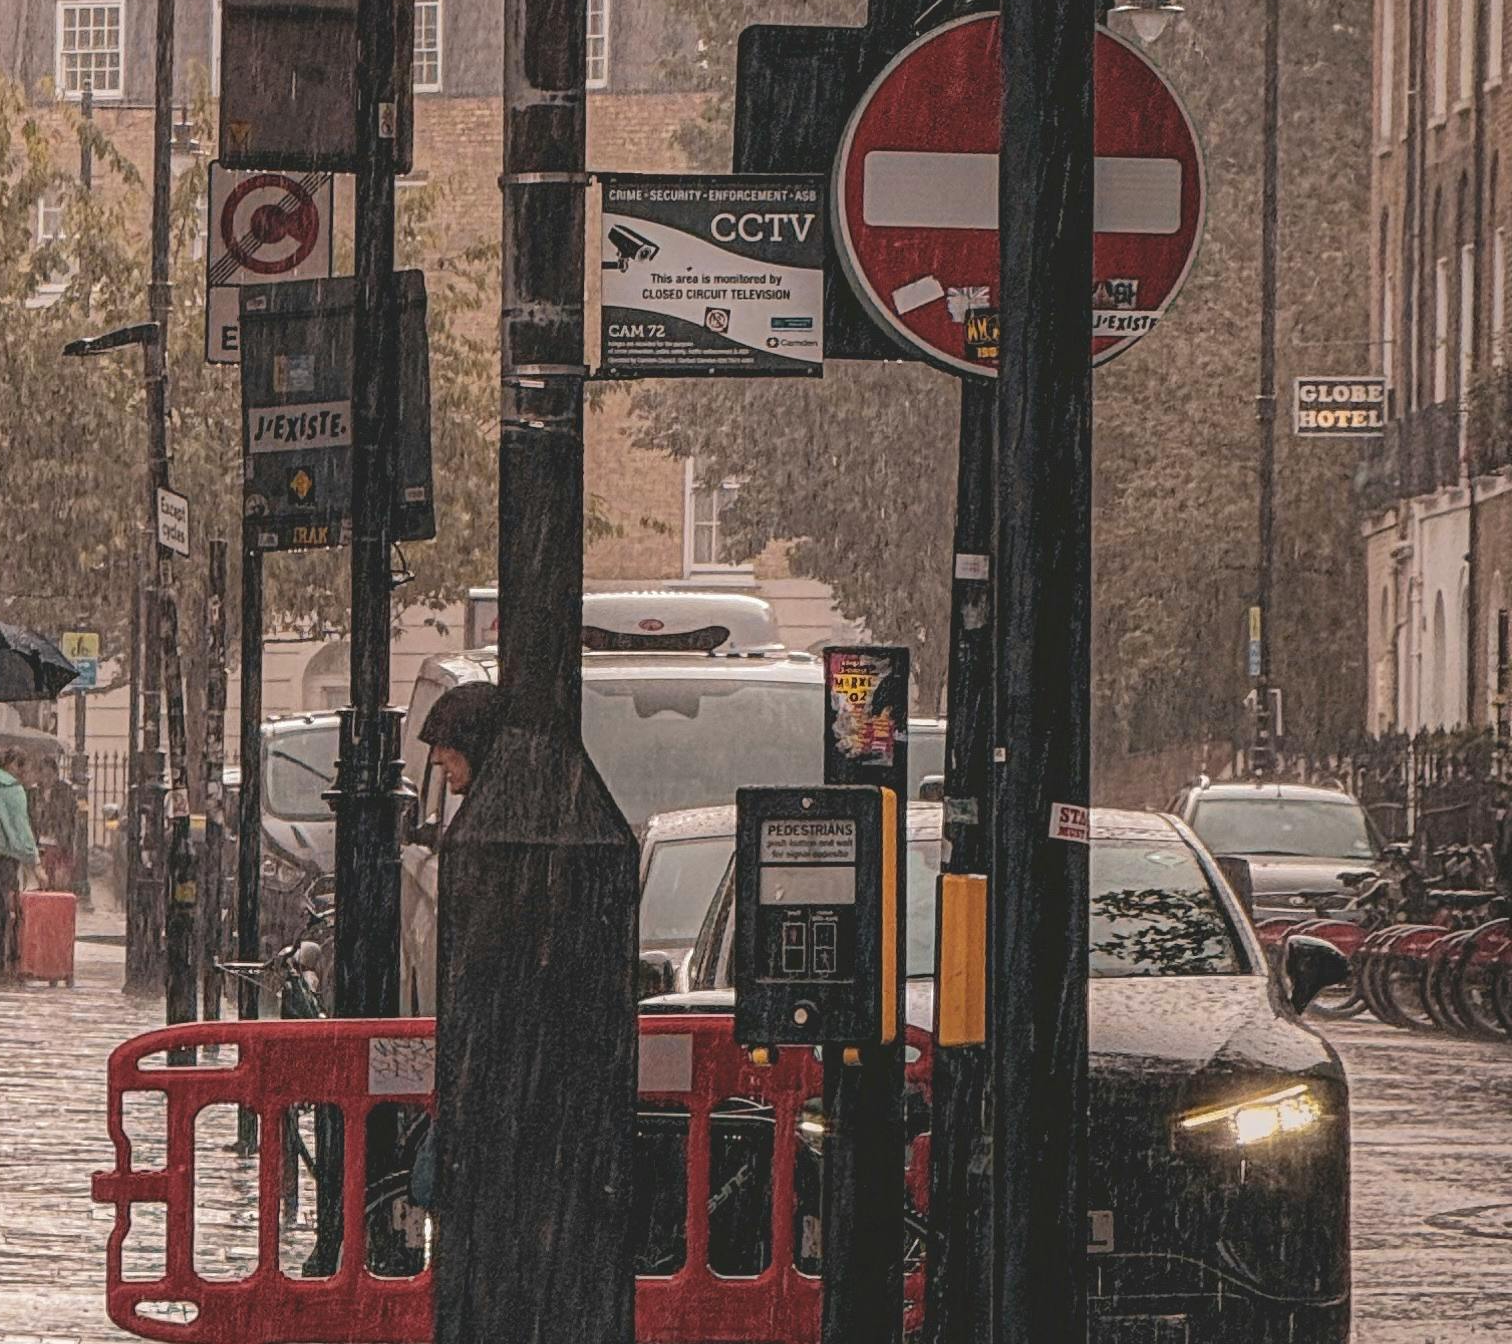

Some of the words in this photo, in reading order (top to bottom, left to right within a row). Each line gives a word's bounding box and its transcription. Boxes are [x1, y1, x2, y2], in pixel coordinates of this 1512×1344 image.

[609, 189, 642, 201] CRIME
[649, 189, 701, 202] SECURITY
[708, 189, 787, 202] ENFORCEMENT
[794, 190, 817, 202] ASB
[710, 212, 815, 243] CCTV
[650, 273, 672, 284] This
[676, 275, 698, 284] area
[701, 273, 711, 284] is
[713, 273, 766, 284] monitored
[768, 273, 782, 286] by
[642, 289, 683, 300] CLOSED
[686, 289, 727, 300] CIRCUIT
[731, 289, 791, 300] TELEVISION
[608, 325, 645, 338] CAM
[648, 324, 666, 338] 72
[1300, 385, 1384, 403] GLOBE
[1300, 410, 1384, 428] HOTEL
[767, 823, 853, 836] PEDESTRIANS
